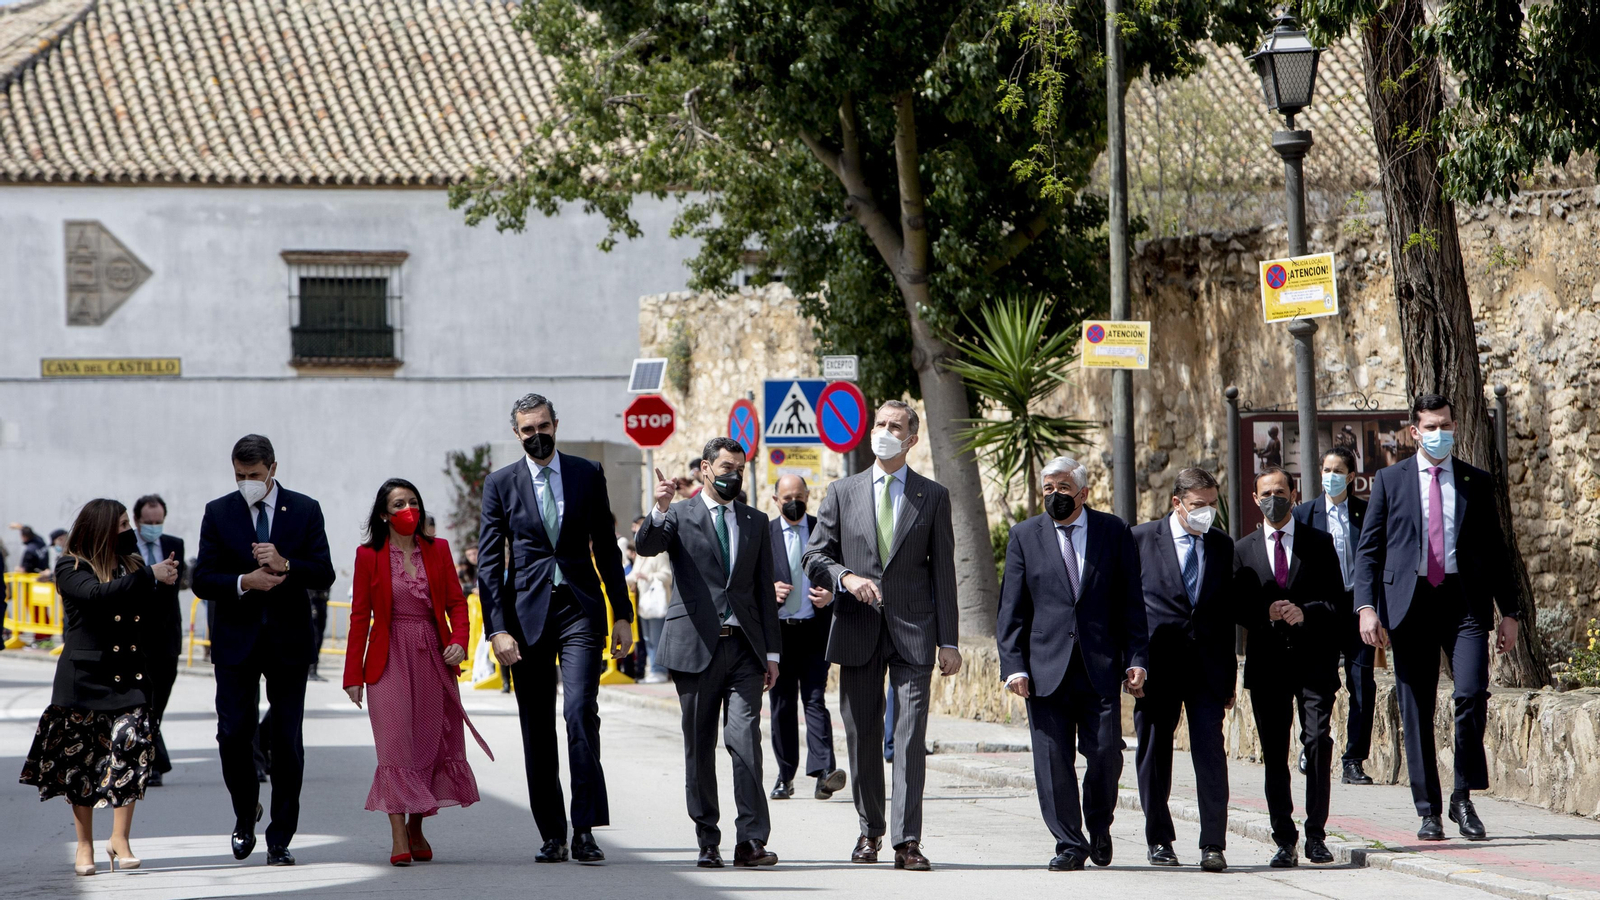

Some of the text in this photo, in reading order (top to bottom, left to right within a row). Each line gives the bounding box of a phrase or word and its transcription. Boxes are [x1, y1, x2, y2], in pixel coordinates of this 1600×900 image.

[1287, 263, 1329, 281] ¡ATENCIÓN!
[1105, 329, 1146, 339] ¡ATENCIÓN!
[46, 360, 175, 372] CAVA DEL CASTILLO
[826, 360, 853, 369] EXCEPTO
[627, 414, 672, 429] STOP
